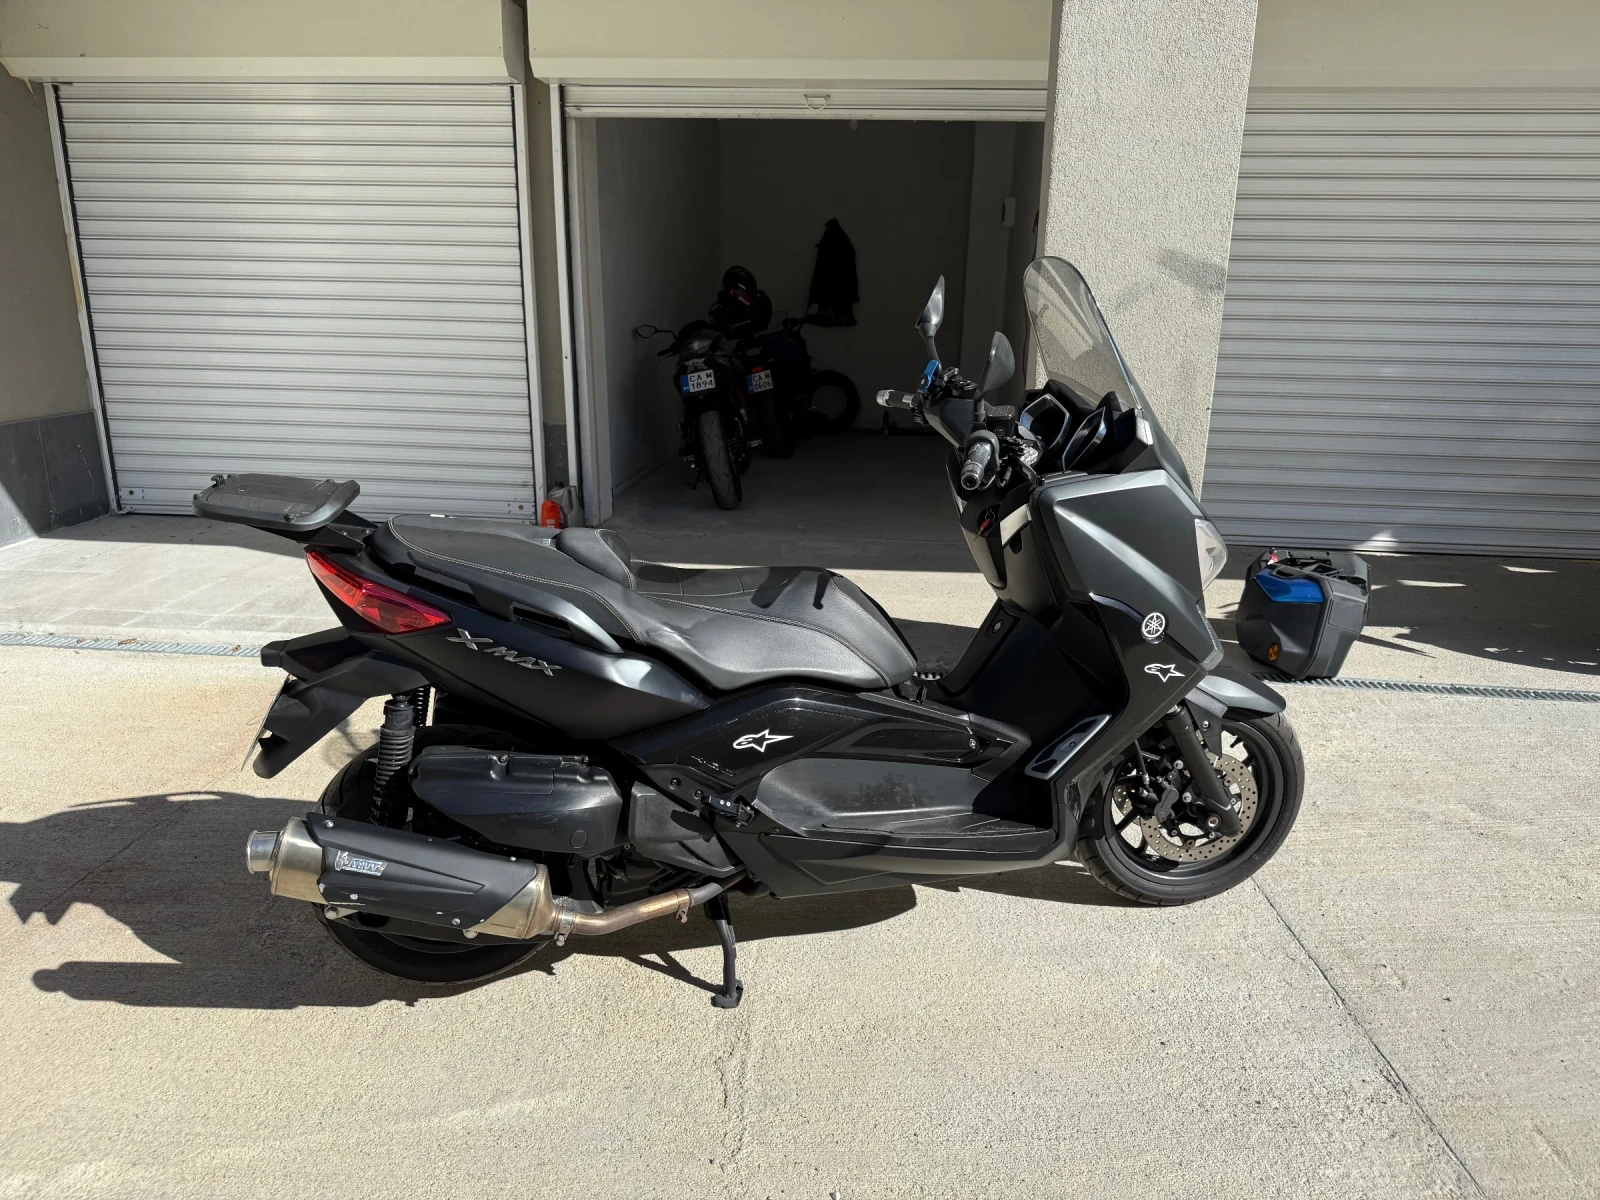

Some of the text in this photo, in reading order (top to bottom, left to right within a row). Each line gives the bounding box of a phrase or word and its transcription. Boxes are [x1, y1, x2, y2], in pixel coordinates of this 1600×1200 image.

[689, 371, 713, 383] CA M
[752, 374, 763, 382] CA
[691, 379, 714, 390] 1894
